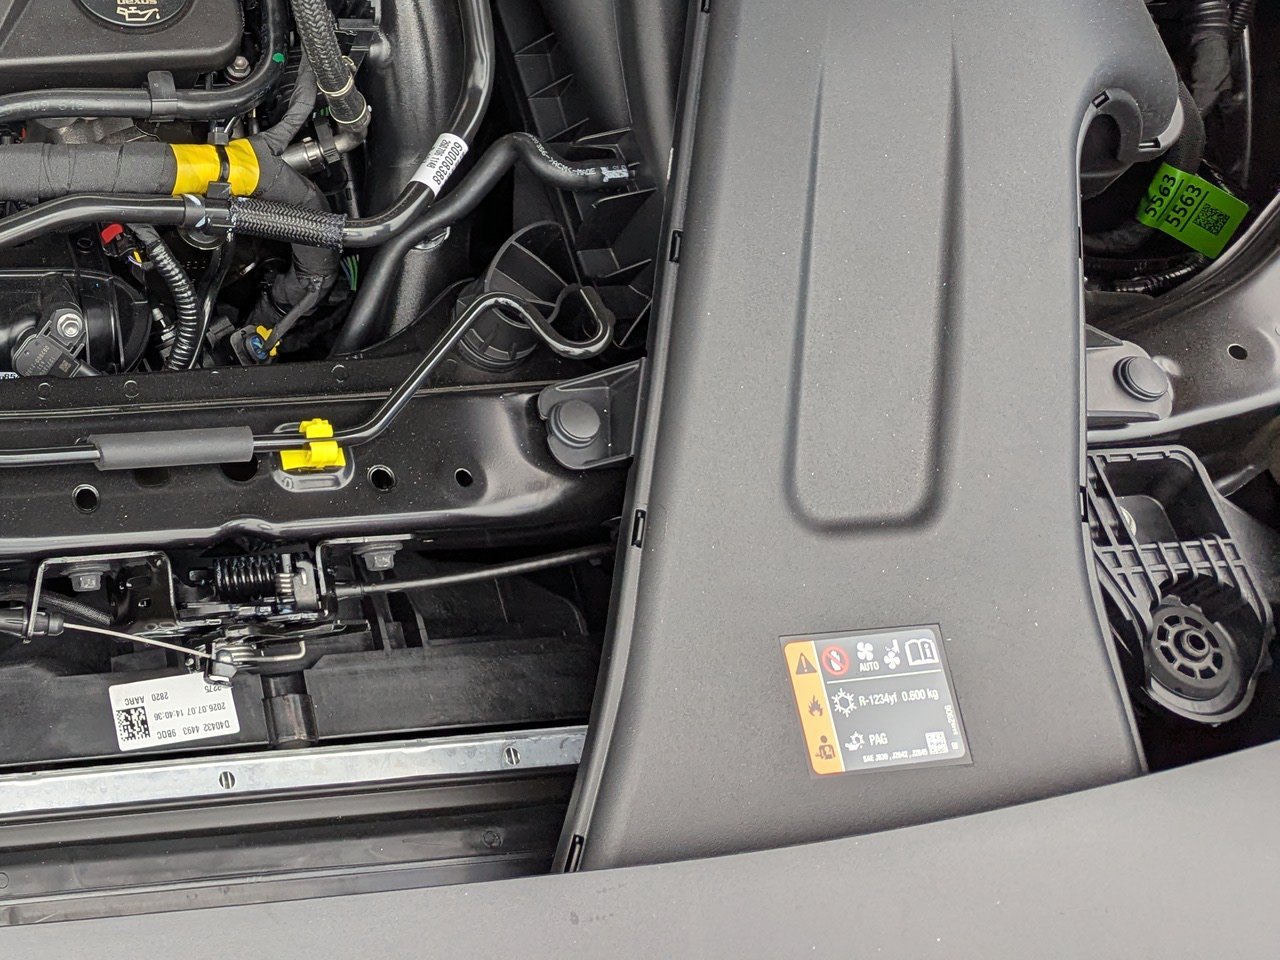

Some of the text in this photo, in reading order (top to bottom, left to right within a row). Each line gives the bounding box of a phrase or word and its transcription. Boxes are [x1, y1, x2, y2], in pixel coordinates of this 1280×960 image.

[1144, 174, 1176, 218] 5563
[1164, 184, 1201, 227] 5563
[859, 661, 879, 672] AUTO
[125, 695, 145, 705] AARC
[151, 692, 169, 702] 2820
[858, 692, 898, 707] R-1234yf
[927, 688, 939, 700] kg
[187, 702, 226, 713] 2026.07.07
[182, 726, 199, 735] 4493
[869, 733, 888, 746] PAG
